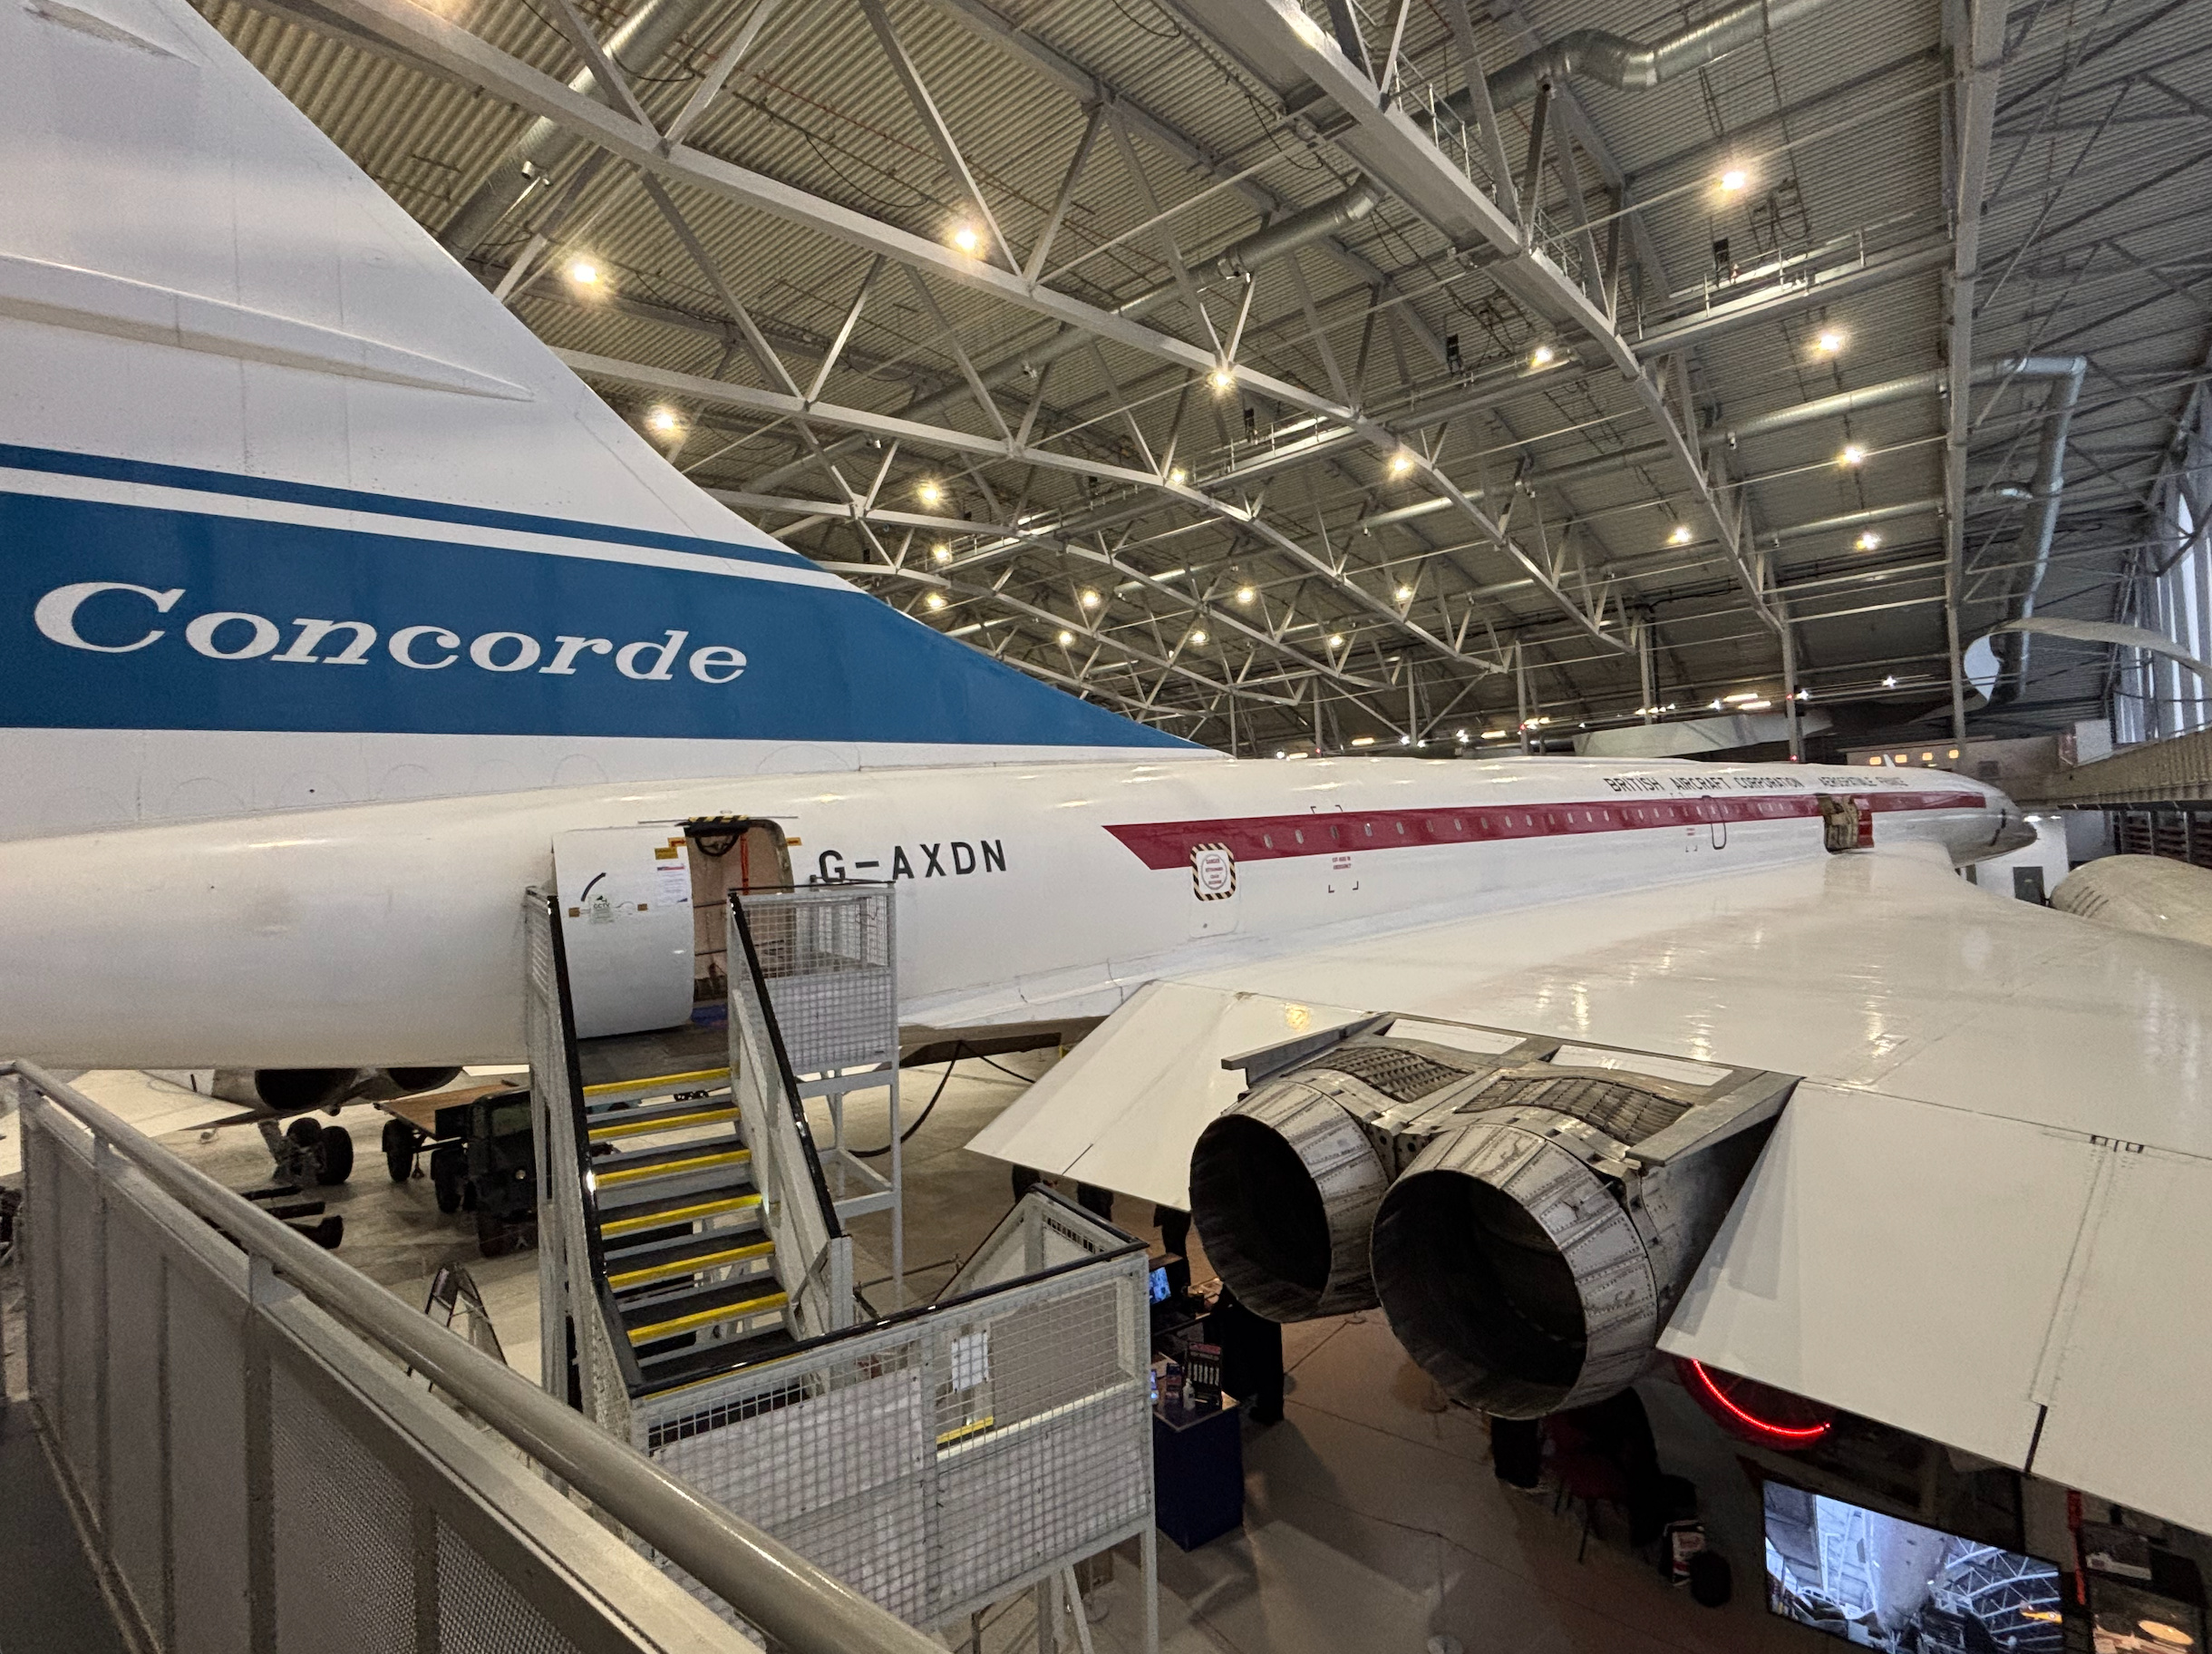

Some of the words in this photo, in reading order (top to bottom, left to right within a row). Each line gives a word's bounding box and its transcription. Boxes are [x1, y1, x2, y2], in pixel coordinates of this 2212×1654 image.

[34, 581, 747, 685] Concorde
[1603, 777, 1665, 793] BRITISH
[1669, 777, 1732, 791] AIRCRAFT
[1733, 776, 1805, 789] CORPORATION
[819, 839, 1006, 884] G-AXDN
